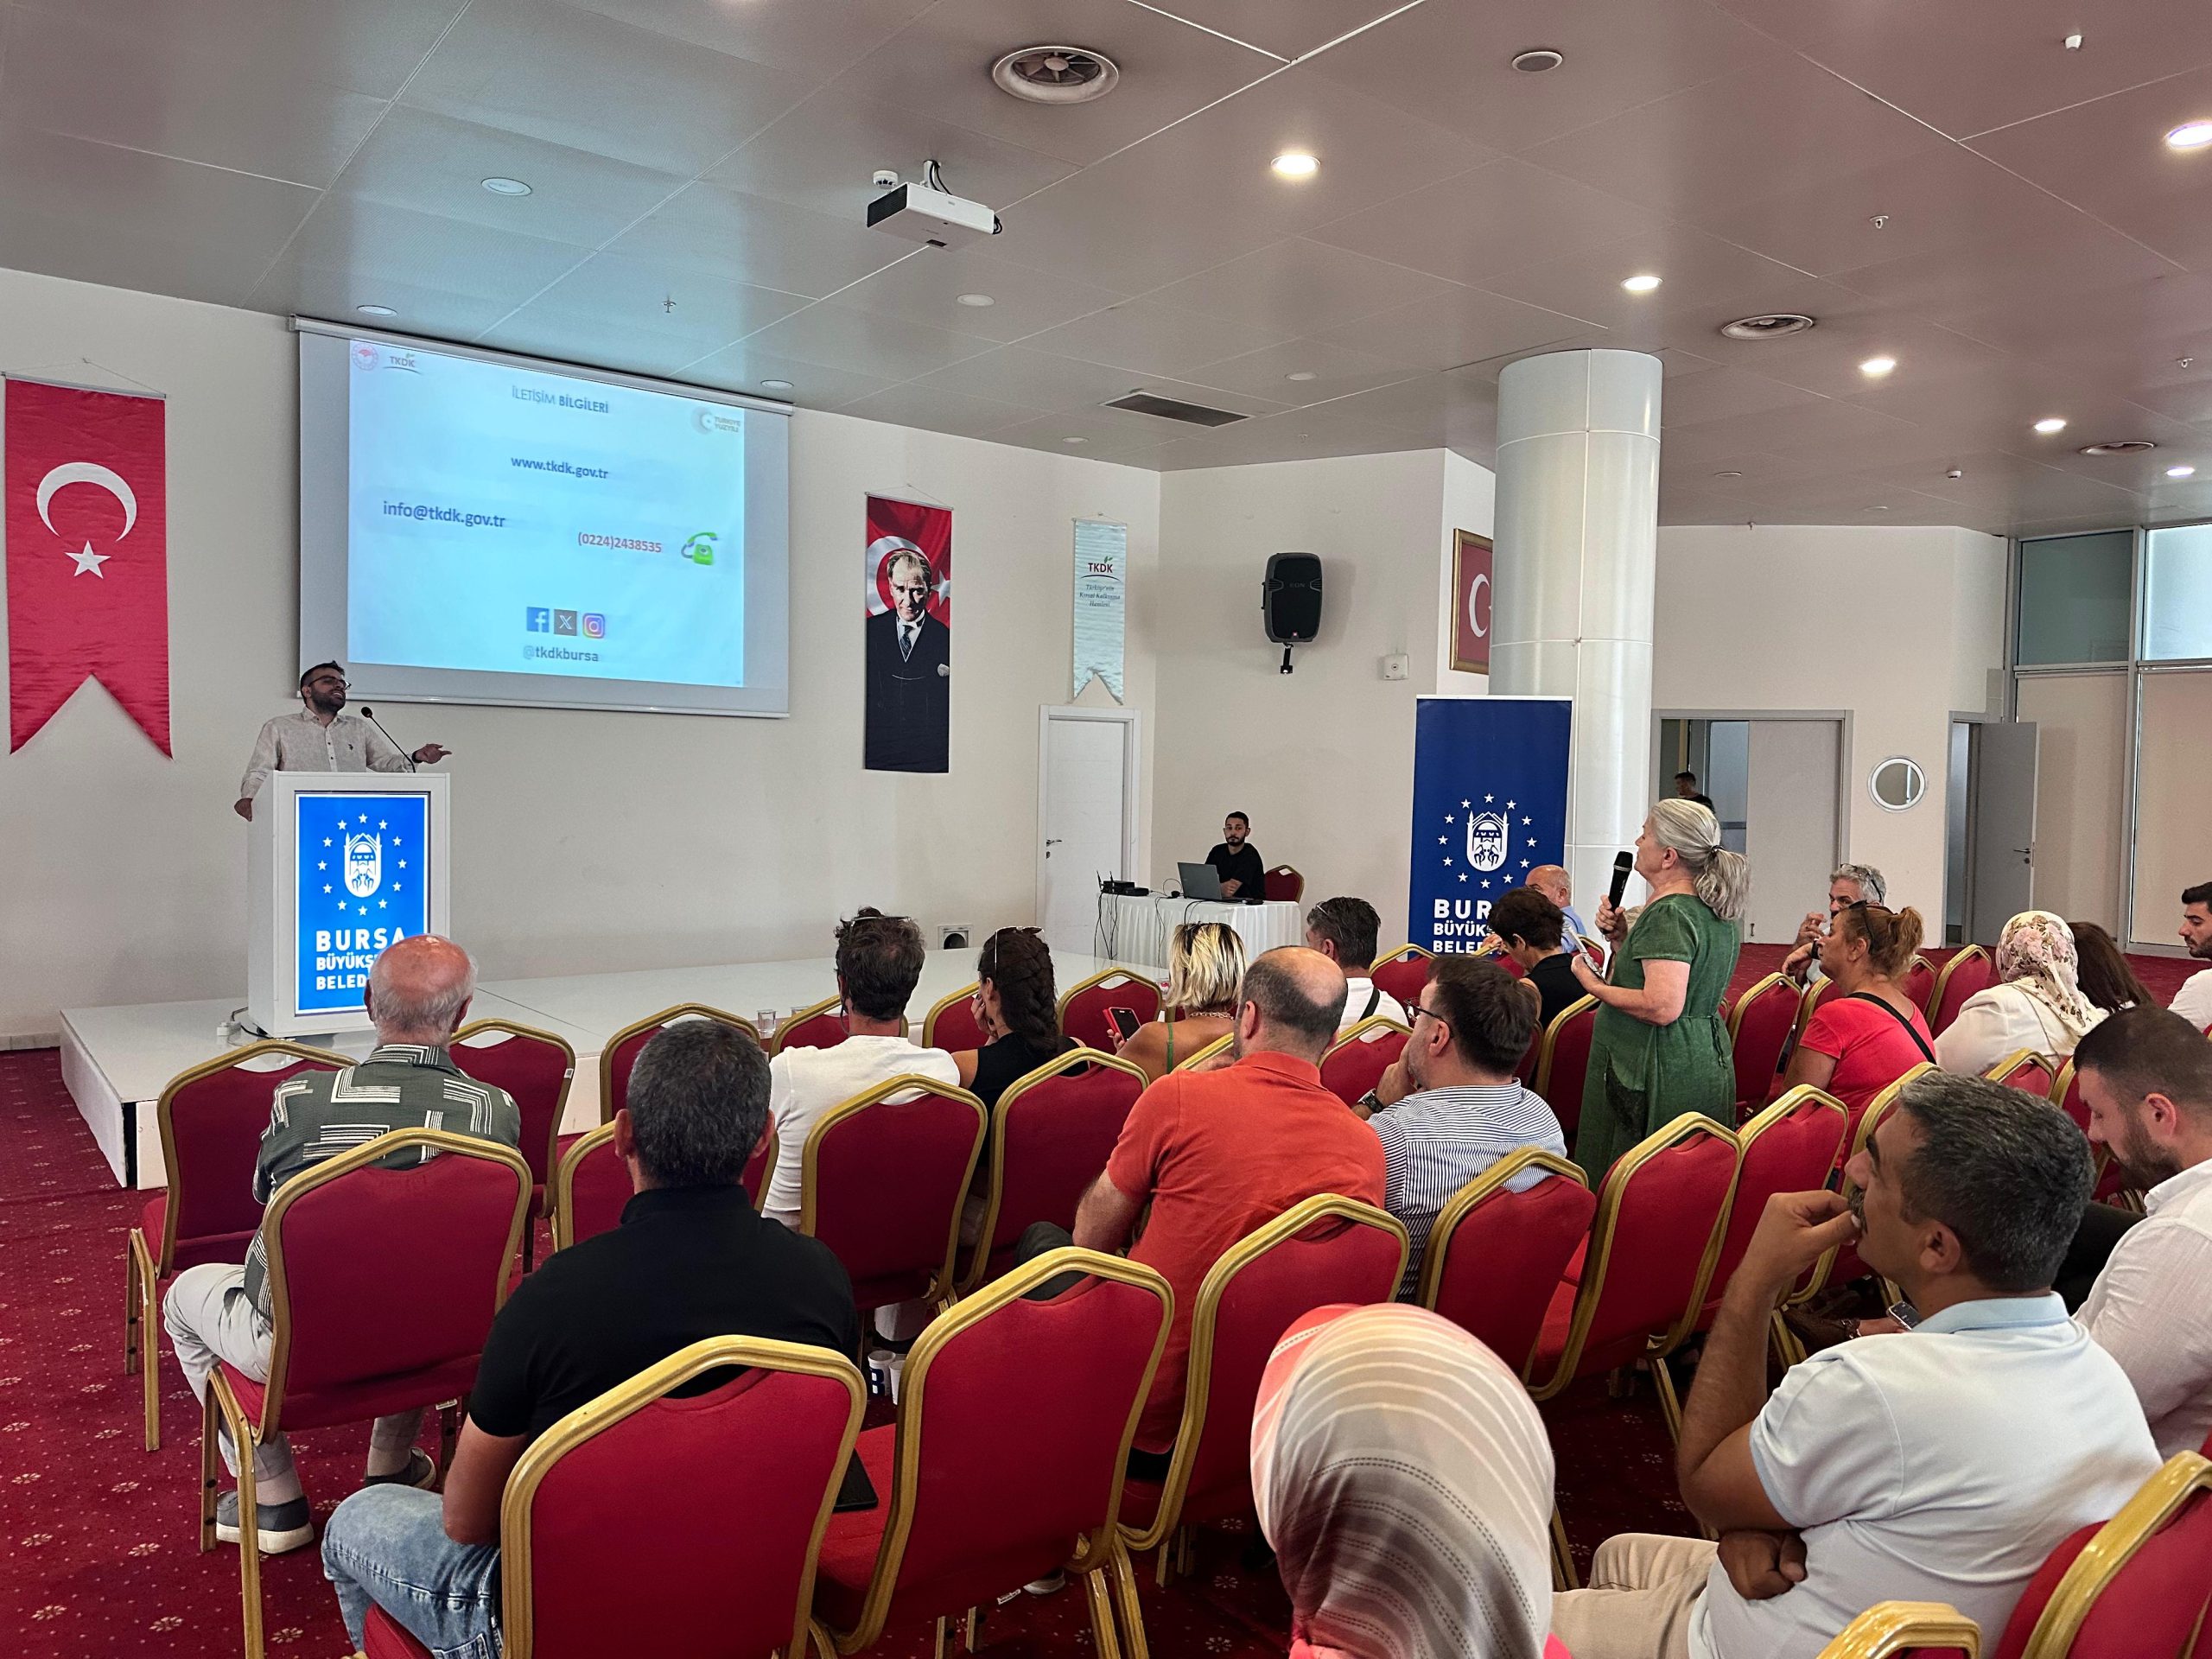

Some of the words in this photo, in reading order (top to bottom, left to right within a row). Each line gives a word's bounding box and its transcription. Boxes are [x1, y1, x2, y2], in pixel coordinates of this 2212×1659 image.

[390, 356, 416, 367] TKDK
[512, 385, 556, 404] İLETİŞİM
[558, 393, 609, 414] BİLGİLERİ
[511, 456, 609, 480] www.tkdk.gov.tr
[383, 500, 506, 527] info@tkdk.gov.tr
[577, 531, 663, 553] (0224)2438535
[1088, 563, 1113, 573] TKDK
[523, 645, 600, 662] @tkdkbursa
[1434, 899, 1492, 920] BUR
[315, 927, 405, 952] BURSA
[315, 952, 378, 975] BÜYÜKŞ
[315, 974, 367, 991] BELED
